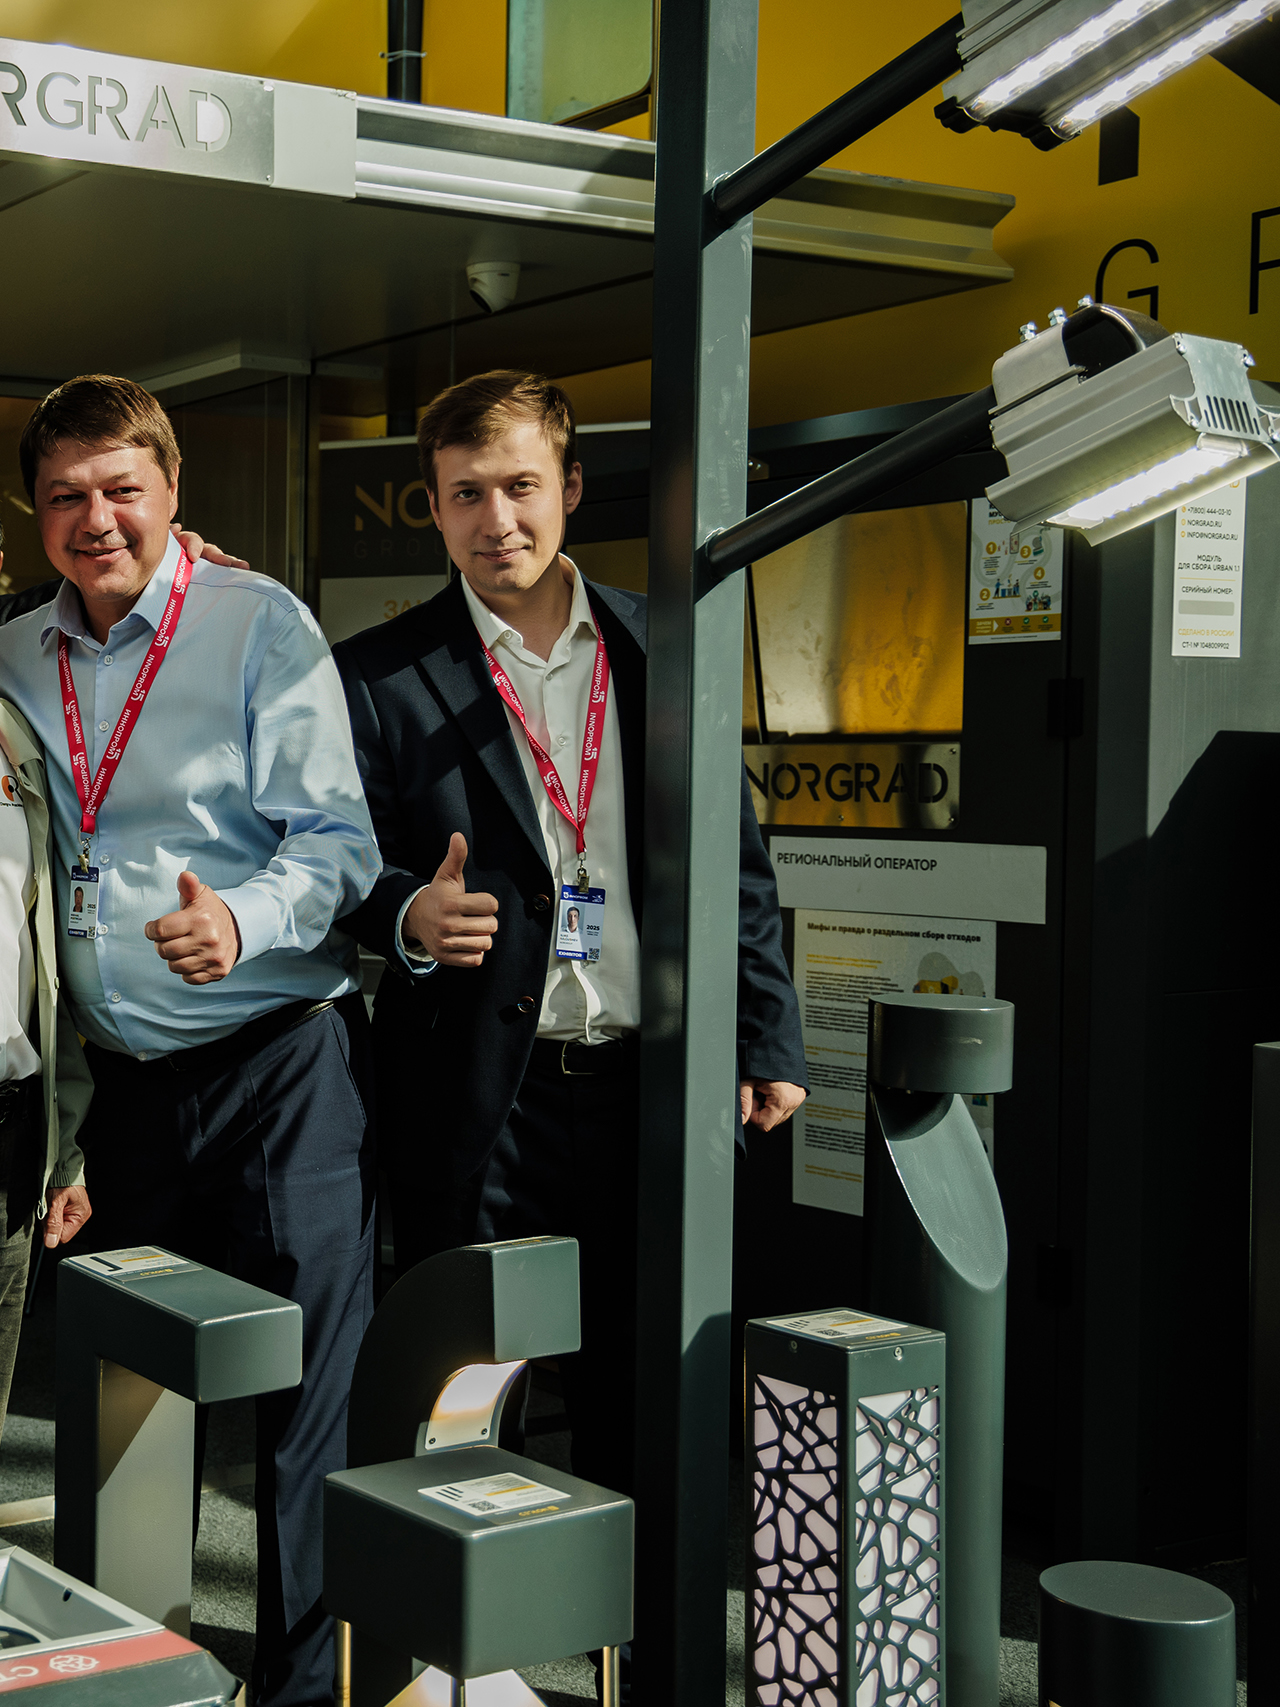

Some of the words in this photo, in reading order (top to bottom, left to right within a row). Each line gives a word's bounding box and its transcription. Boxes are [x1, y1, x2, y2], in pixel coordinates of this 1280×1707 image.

[1187, 519, 1222, 528] NORGRAD.RU
[1187, 531, 1238, 541] INFO@NORGRAD.RU
[1178, 563, 1191, 571] ДЛЯ
[1192, 563, 1211, 571] СБОРА
[1213, 564, 1233, 572] URBAN
[1197, 555, 1222, 563] МОДУЛЬ
[1181, 586, 1212, 594] СЕРИЙНЫЙ
[154, 598, 177, 646] ИННОПРОМ
[1178, 628, 1205, 636] СДЕЛАНО
[1211, 629, 1234, 637] РОССИИ
[60, 649, 73, 692] ИННОПРОМ
[132, 653, 155, 697] INNOPROM
[592, 651, 605, 698] ИННОПРОМ
[69, 704, 82, 743] INNOPROM
[107, 708, 131, 755] ИННОПРОМ
[585, 712, 596, 760] INNOPROM
[85, 766, 107, 814] ИННОПРОМ
[577, 769, 588, 817] ИННОПРОМ
[745, 763, 948, 803] NORGRAD
[777, 852, 871, 869] РЕГИОНАЛЬНЫЙ
[874, 857, 937, 871] ОПЕРАТОР
[807, 922, 830, 934] Мифы
[839, 926, 865, 935] правда
[873, 928, 920, 938] раздельном
[922, 930, 945, 941] сборе
[947, 934, 981, 944] отходов
